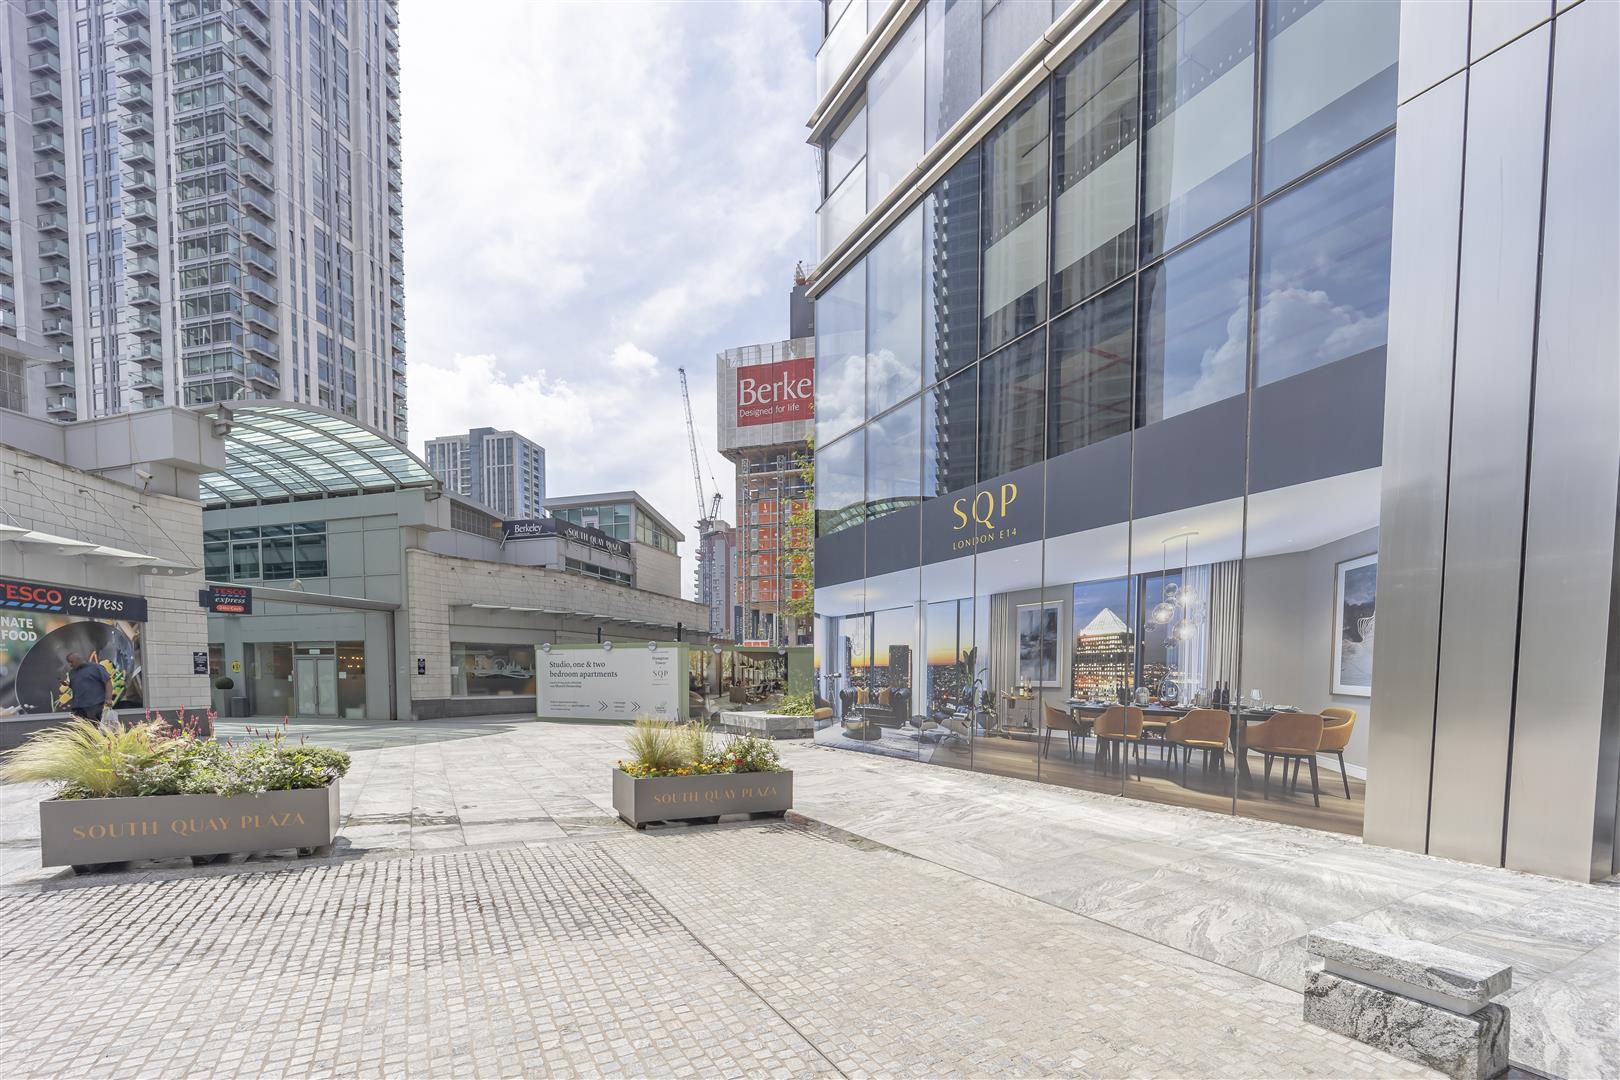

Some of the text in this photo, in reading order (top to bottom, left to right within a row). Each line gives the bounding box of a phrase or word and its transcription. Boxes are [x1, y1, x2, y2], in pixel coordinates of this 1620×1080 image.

[740, 403, 800, 417] Designed for life
[953, 483, 1018, 530] SQP
[953, 527, 1017, 551] LONDON E14
[214, 587, 247, 596] TESCO
[69, 593, 124, 612] express
[0, 616, 33, 628] NATE
[1, 630, 37, 641] FOOD
[549, 660, 572, 669] Studio,
[549, 670, 618, 679] bedroom apartments
[652, 670, 669, 679] SQP
[654, 786, 777, 804] SOUTH QUAY PLAZA
[72, 812, 305, 840] SOUTH QUAY PLAZA
